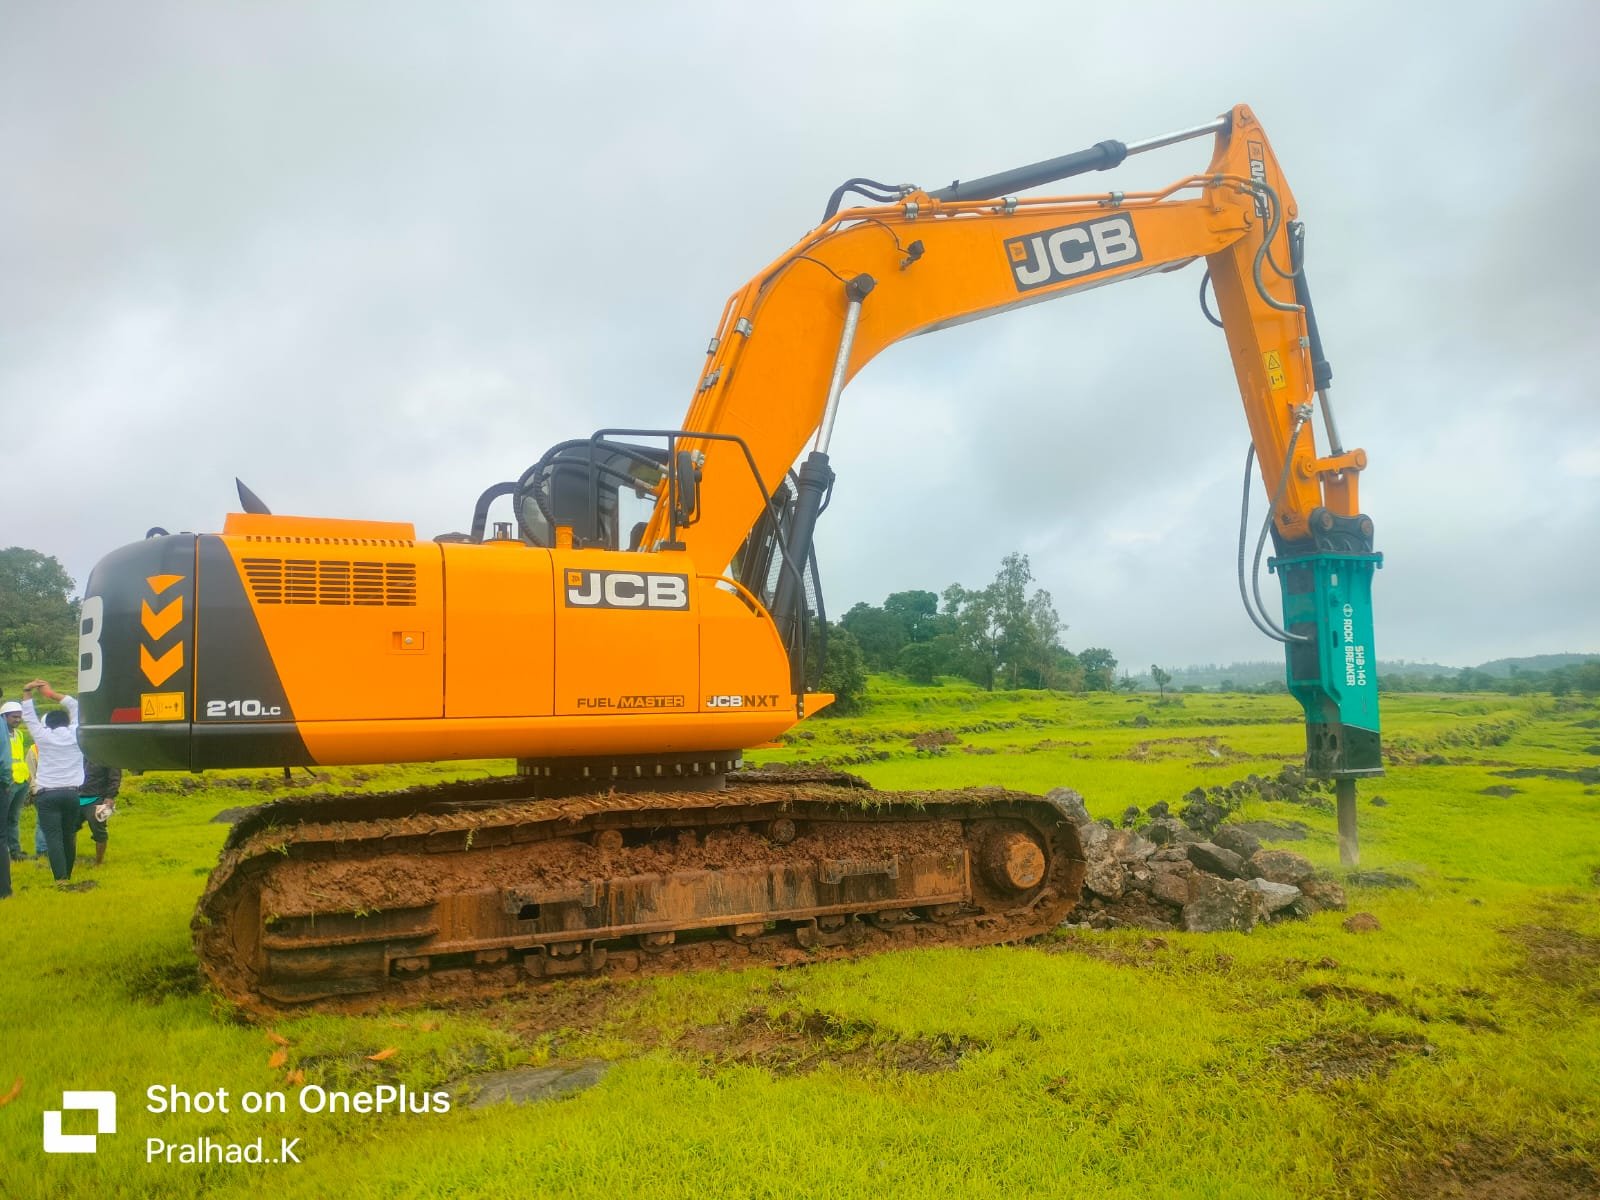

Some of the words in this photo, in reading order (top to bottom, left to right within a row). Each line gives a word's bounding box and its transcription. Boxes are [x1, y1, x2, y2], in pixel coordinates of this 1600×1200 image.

[1015, 218, 1137, 285] JCB
[568, 573, 687, 608] JCB
[1343, 618, 1353, 643] ROCK
[1344, 646, 1356, 686] BREAKER
[577, 697, 616, 708] FUEL
[619, 696, 684, 708] MASTER
